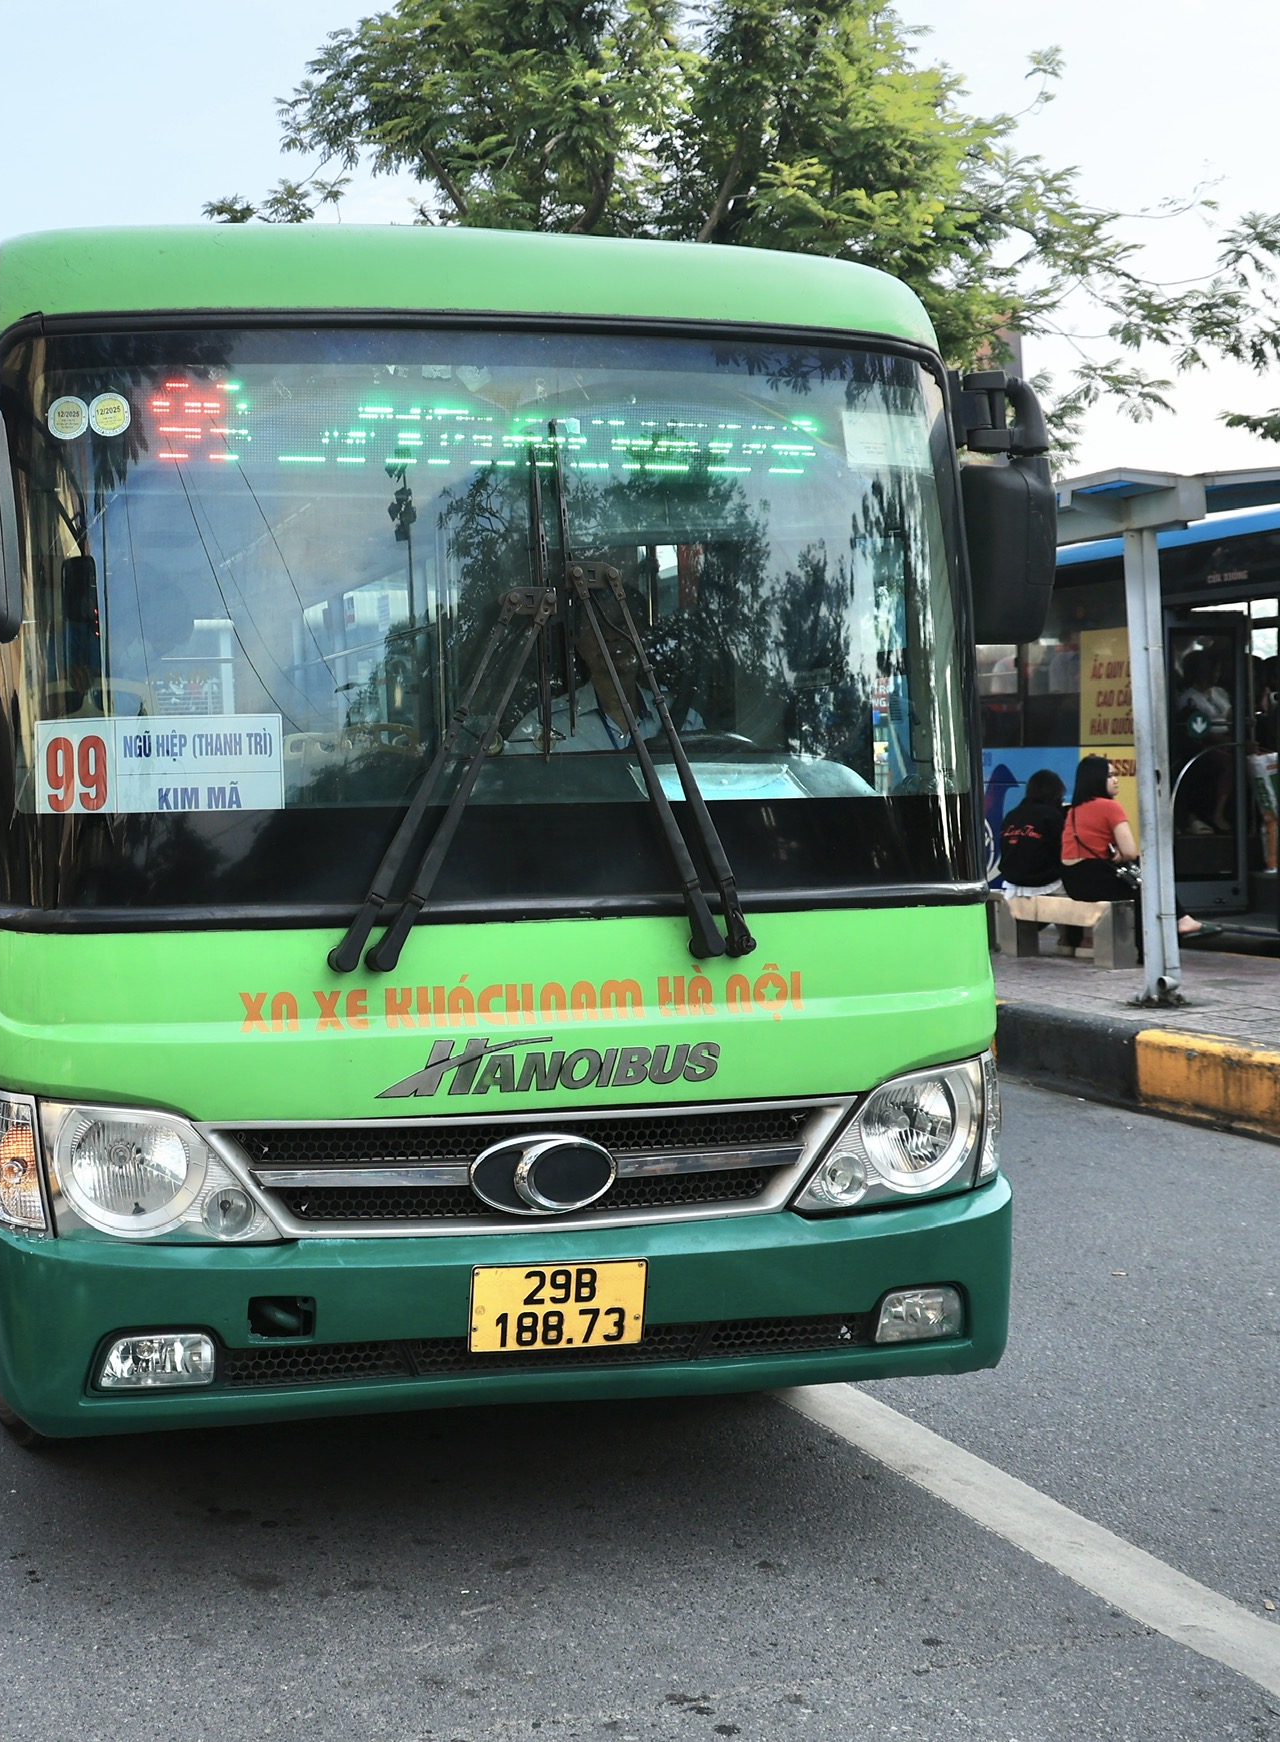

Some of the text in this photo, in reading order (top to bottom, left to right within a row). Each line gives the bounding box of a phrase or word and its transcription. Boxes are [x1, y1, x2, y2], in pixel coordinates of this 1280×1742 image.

[57, 410, 80, 418] 12/2025
[96, 405, 122, 416] 12/2025
[123, 729, 273, 762] NGŨ HIỆP (THANH TRÌ)
[46, 735, 108, 812] 99
[158, 781, 242, 810] KIM MÃ
[312, 988, 370, 1032] XE
[384, 974, 537, 1029] KHÁCH
[540, 978, 646, 1022] NAM
[657, 964, 716, 1017] HÀ
[725, 963, 804, 1022] NỘI
[374, 1036, 721, 1099] HANOIBUS
[523, 1268, 597, 1305] 29B
[495, 1307, 625, 1348] 188.73
